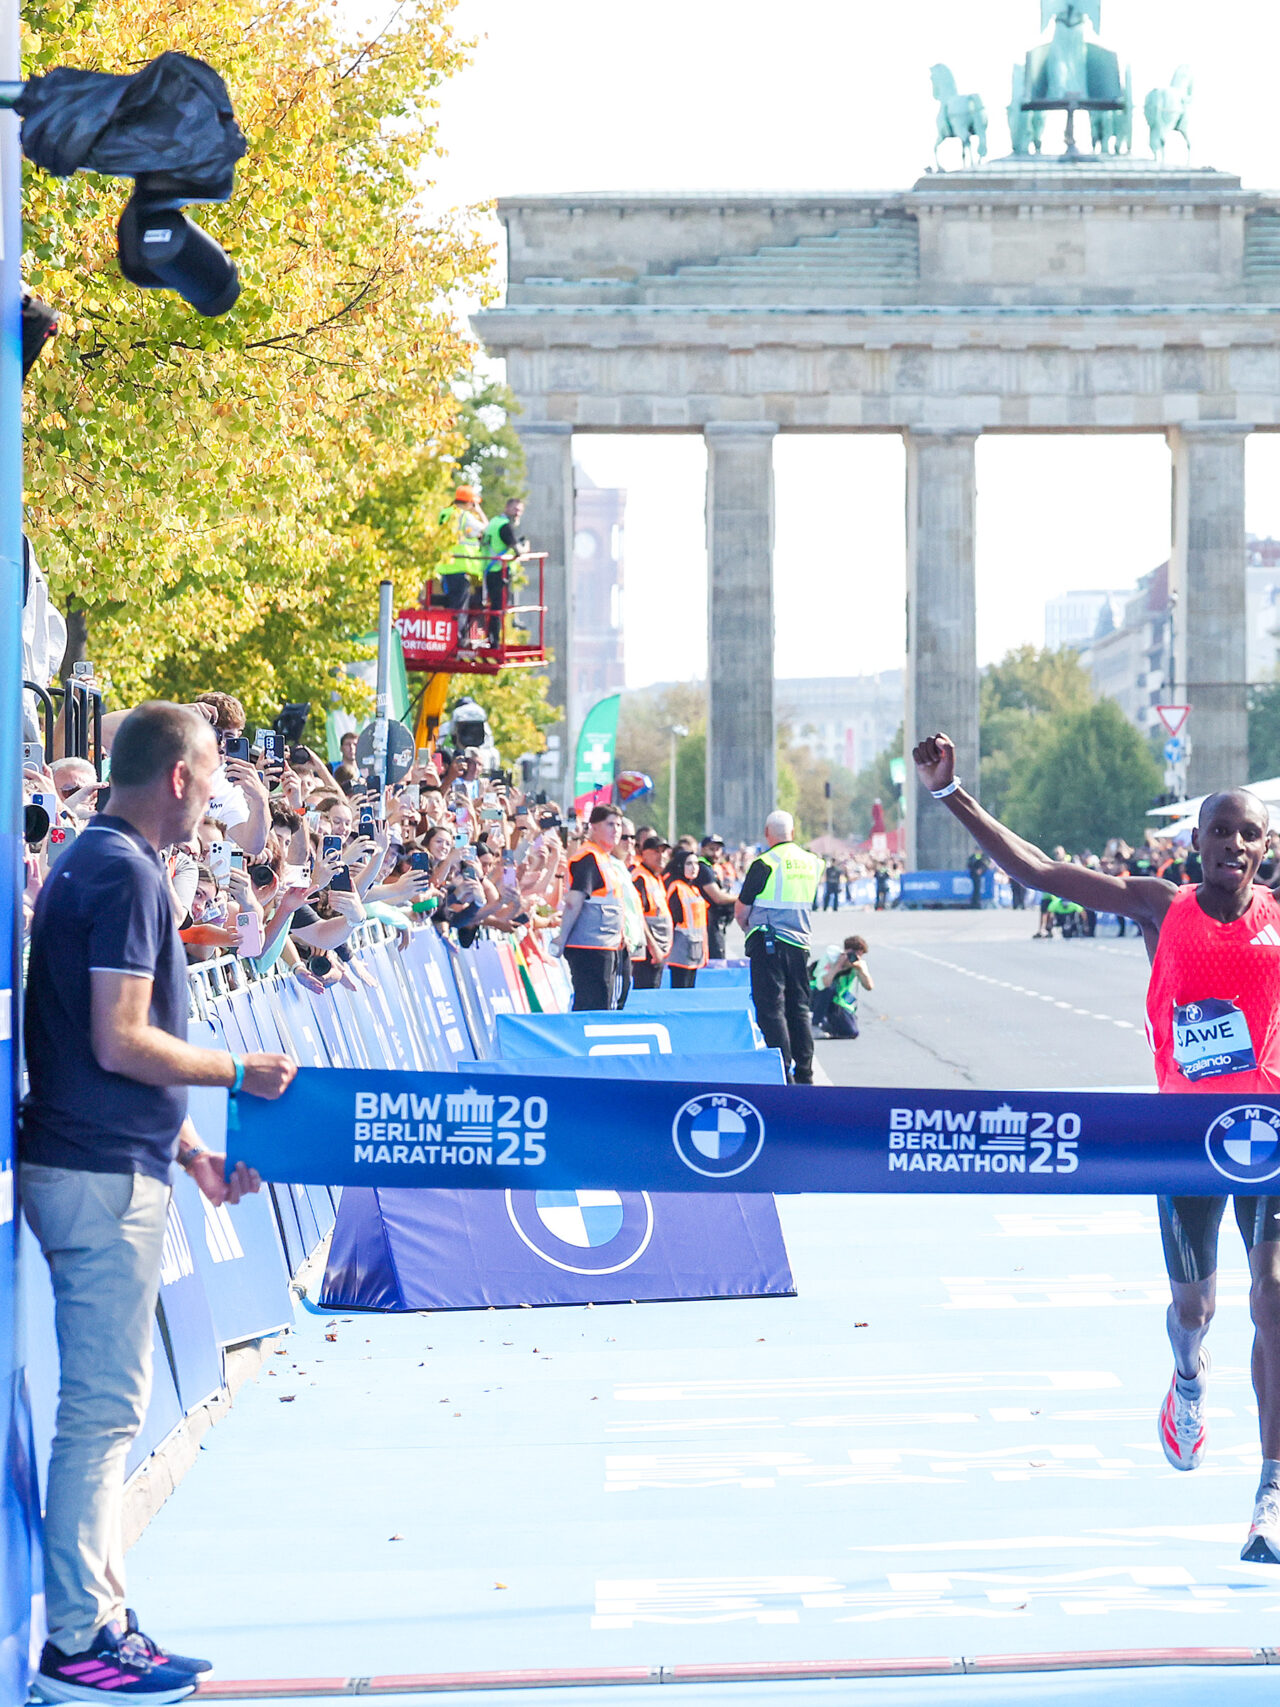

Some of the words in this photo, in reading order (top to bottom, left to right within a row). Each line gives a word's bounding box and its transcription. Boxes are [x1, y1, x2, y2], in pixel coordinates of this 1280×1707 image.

[395, 618, 451, 641] SMILE!
[1185, 1055, 1231, 1074] zalando
[355, 1092, 442, 1120] BMW
[497, 1096, 548, 1129] 20
[686, 1097, 752, 1117] BMW
[889, 1108, 976, 1132] BMW
[1031, 1112, 1081, 1140] 20
[355, 1122, 442, 1142] BERLIN
[889, 1132, 976, 1151] BERLIN
[354, 1145, 493, 1165] MARATHON
[496, 1132, 547, 1165] 25
[1029, 1142, 1079, 1173] 25
[888, 1153, 1026, 1173] MARATHON
